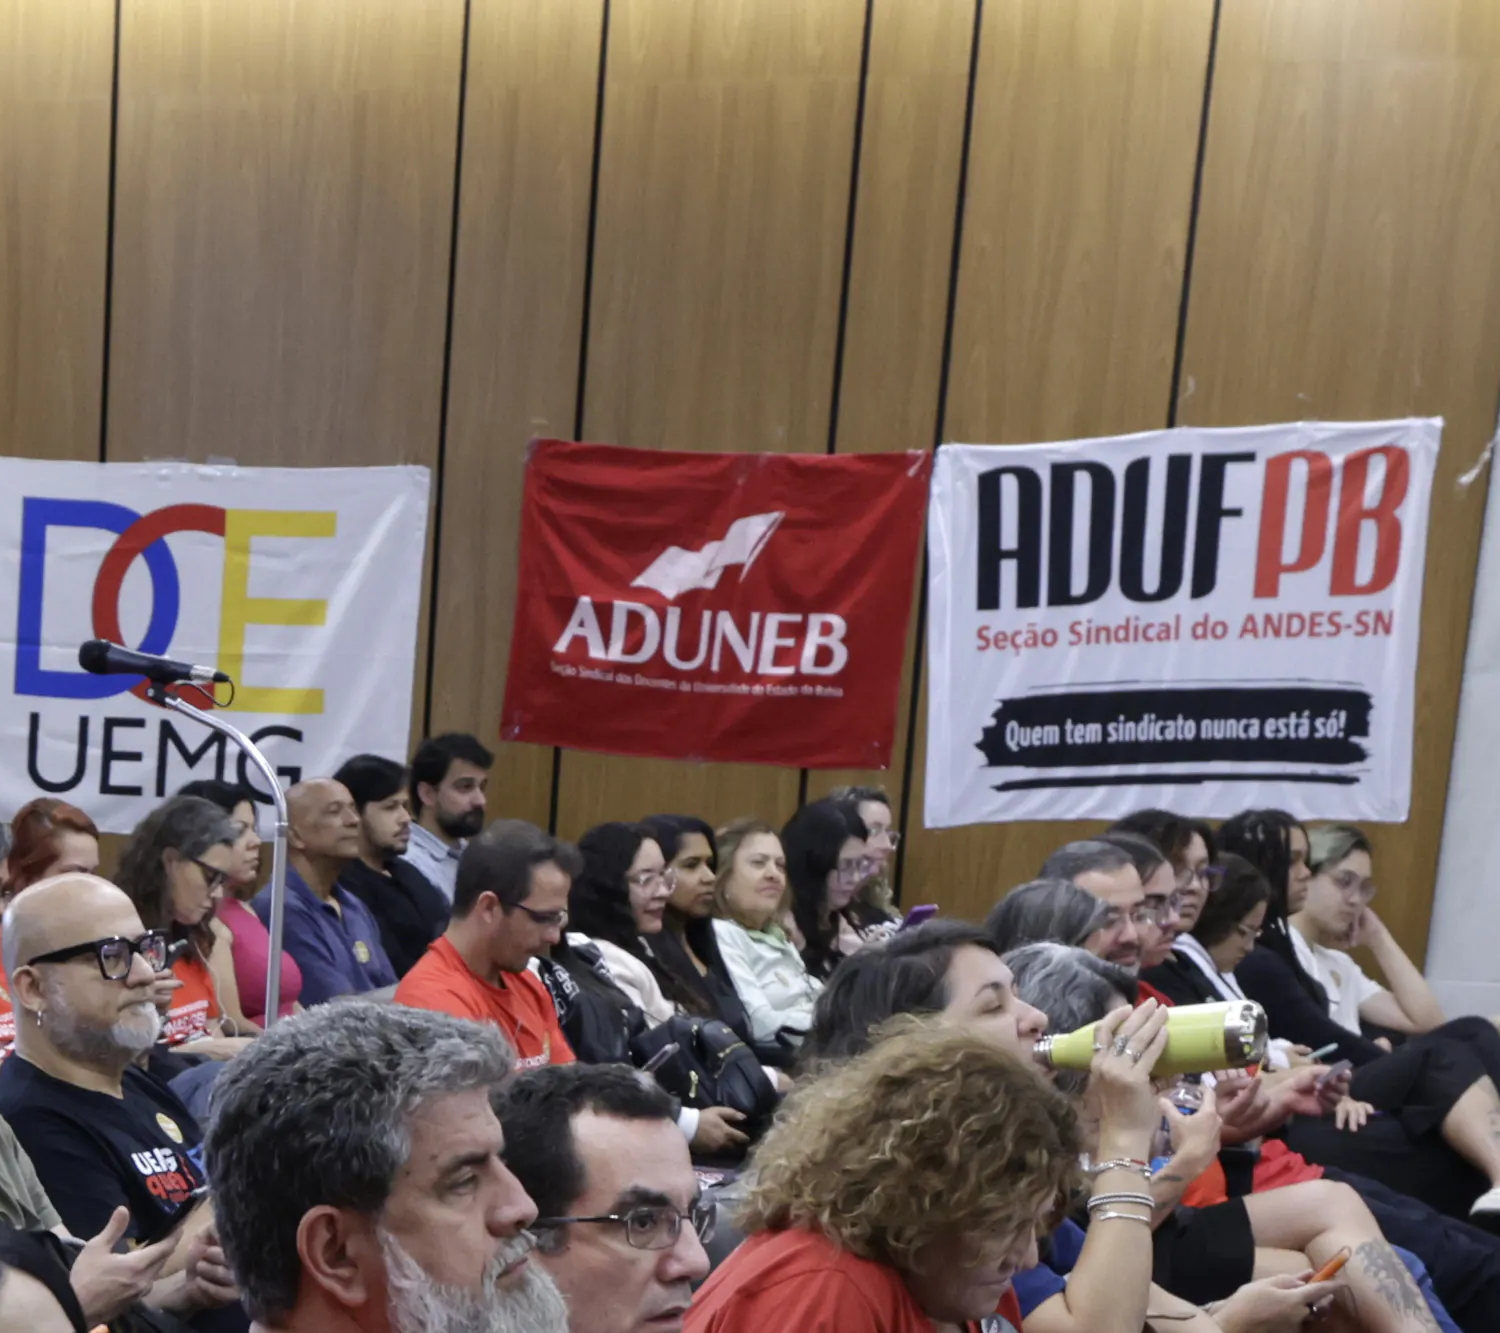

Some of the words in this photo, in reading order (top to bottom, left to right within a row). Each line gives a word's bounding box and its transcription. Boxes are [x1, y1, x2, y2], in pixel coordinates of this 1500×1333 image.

[14, 496, 338, 715] DCE
[551, 596, 848, 675] ADUNEB
[975, 622, 1058, 656] Seção
[1068, 614, 1181, 646] Sindical
[1190, 613, 1230, 641] do
[1239, 609, 1394, 640] ANDES-SN
[28, 711, 304, 806] UEMG
[1005, 719, 1060, 751] Quem
[1064, 718, 1102, 745] tem
[1106, 713, 1197, 744] sindicato
[1200, 716, 1260, 741] nunca
[1264, 711, 1310, 740] está
[1314, 709, 1348, 740] só!
